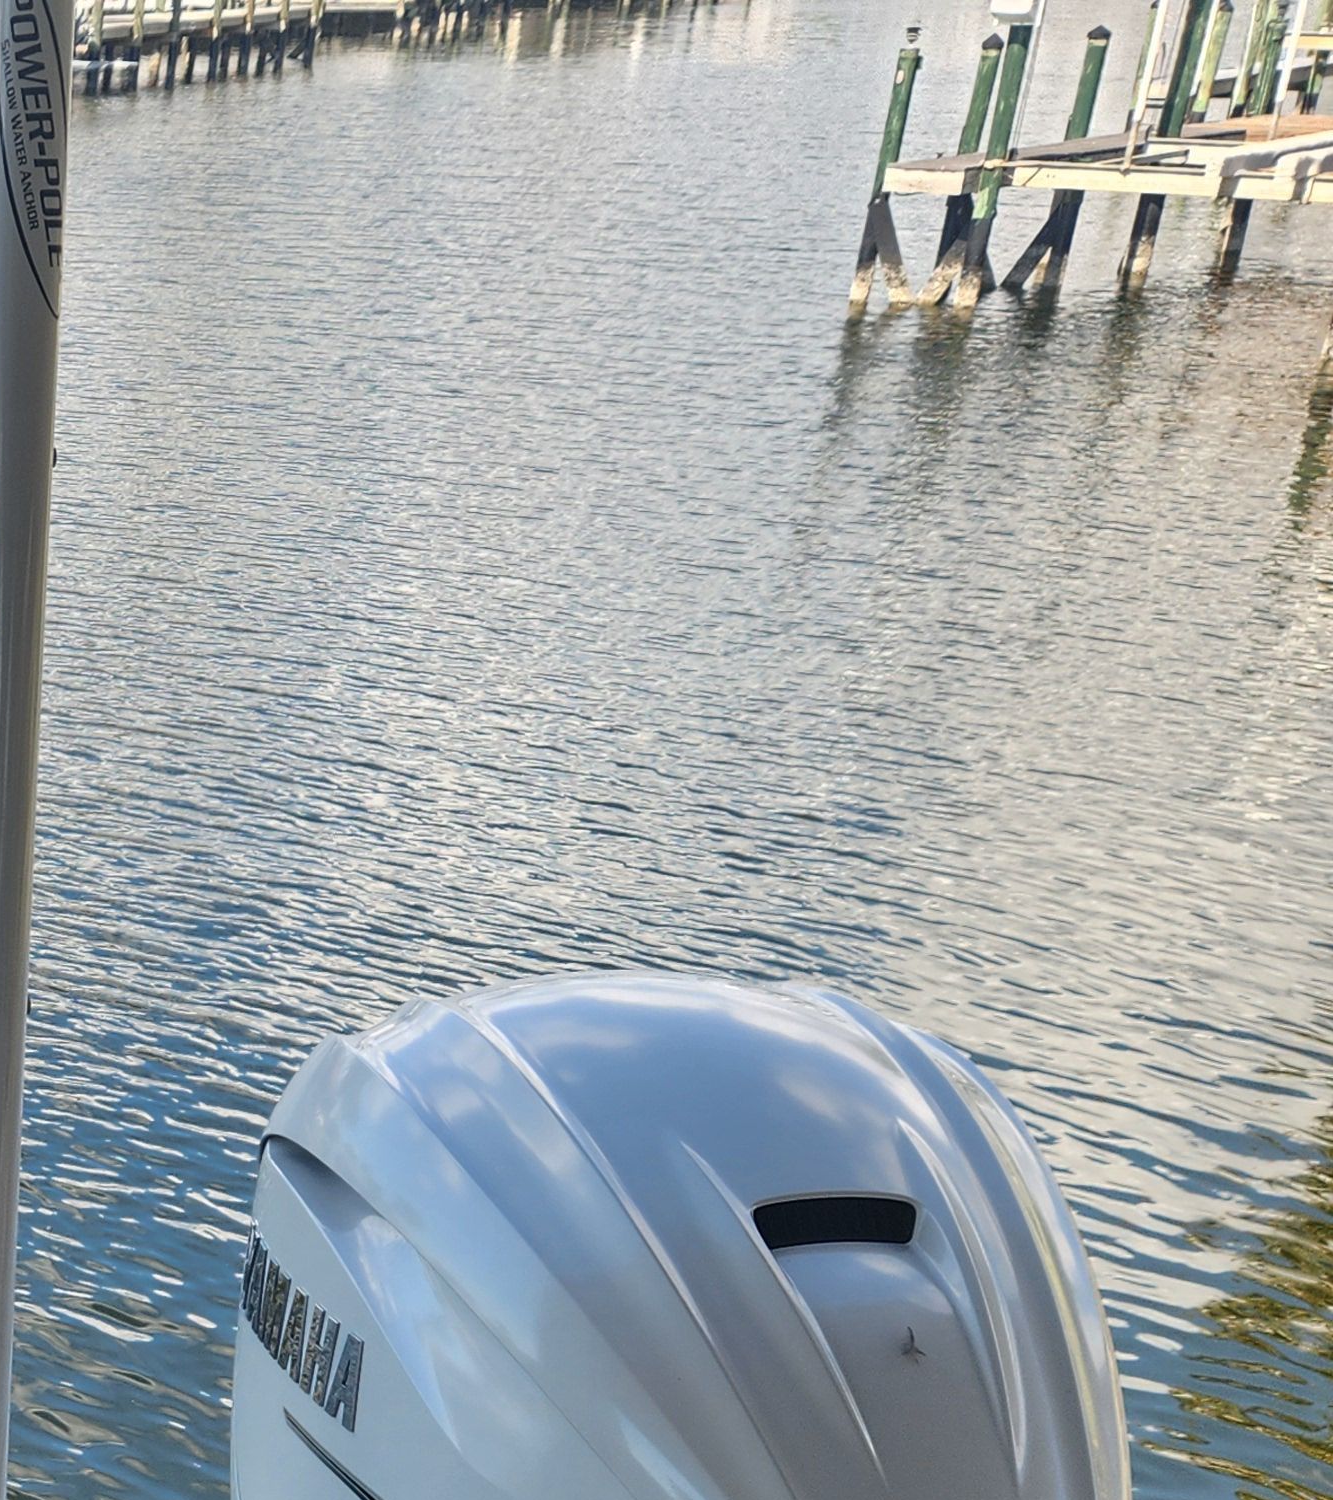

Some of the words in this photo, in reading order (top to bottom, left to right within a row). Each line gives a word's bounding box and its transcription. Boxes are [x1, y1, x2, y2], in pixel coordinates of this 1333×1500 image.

[1, 38, 20, 110] SHALLOW
[11, 113, 28, 166] WATER
[20, 170, 40, 231] ANCHOR
